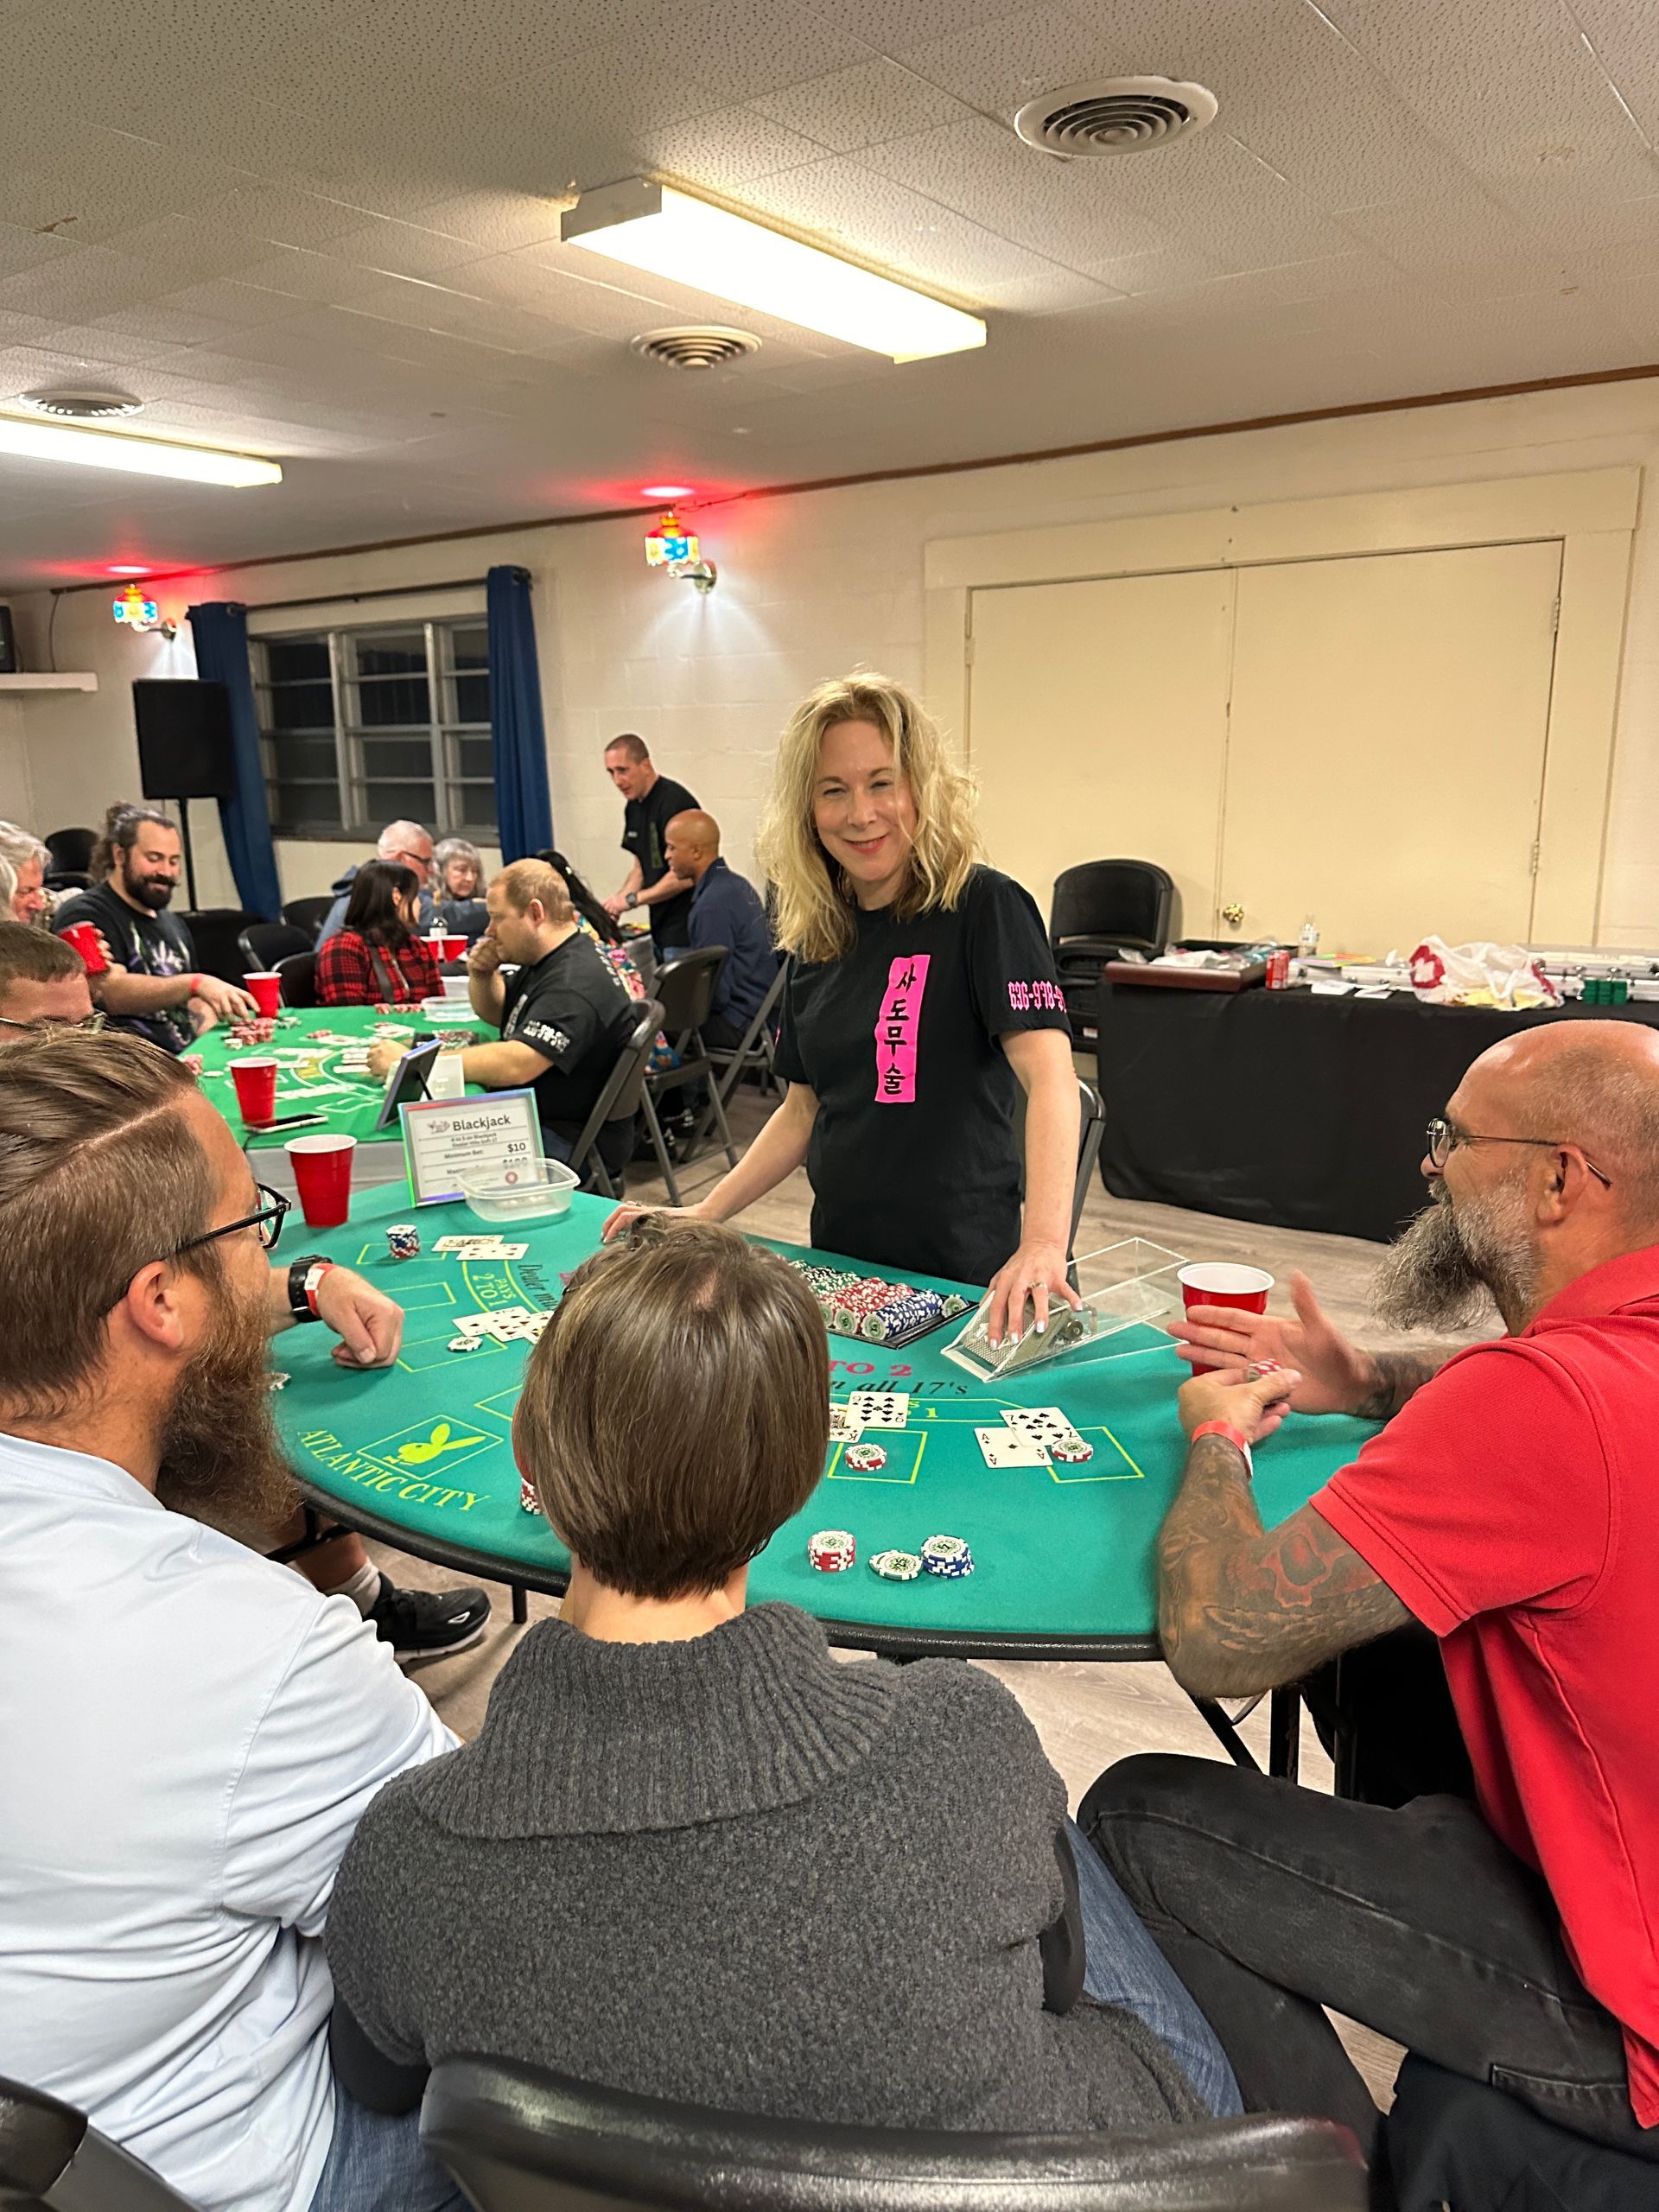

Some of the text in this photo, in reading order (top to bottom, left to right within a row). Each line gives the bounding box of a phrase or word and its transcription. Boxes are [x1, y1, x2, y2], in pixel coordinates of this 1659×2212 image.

[453, 1115, 511, 1131] Blackjack
[507, 1142, 526, 1153] $10
[518, 1264, 550, 1291] Dealer
[476, 1282, 499, 1299] TO
[494, 1278, 517, 1300] PAYS
[889, 1364, 912, 1377] 2
[856, 1380, 899, 1392] all
[912, 1382, 969, 1395] 17's
[297, 1429, 492, 1511] ATLANTIC CITY
